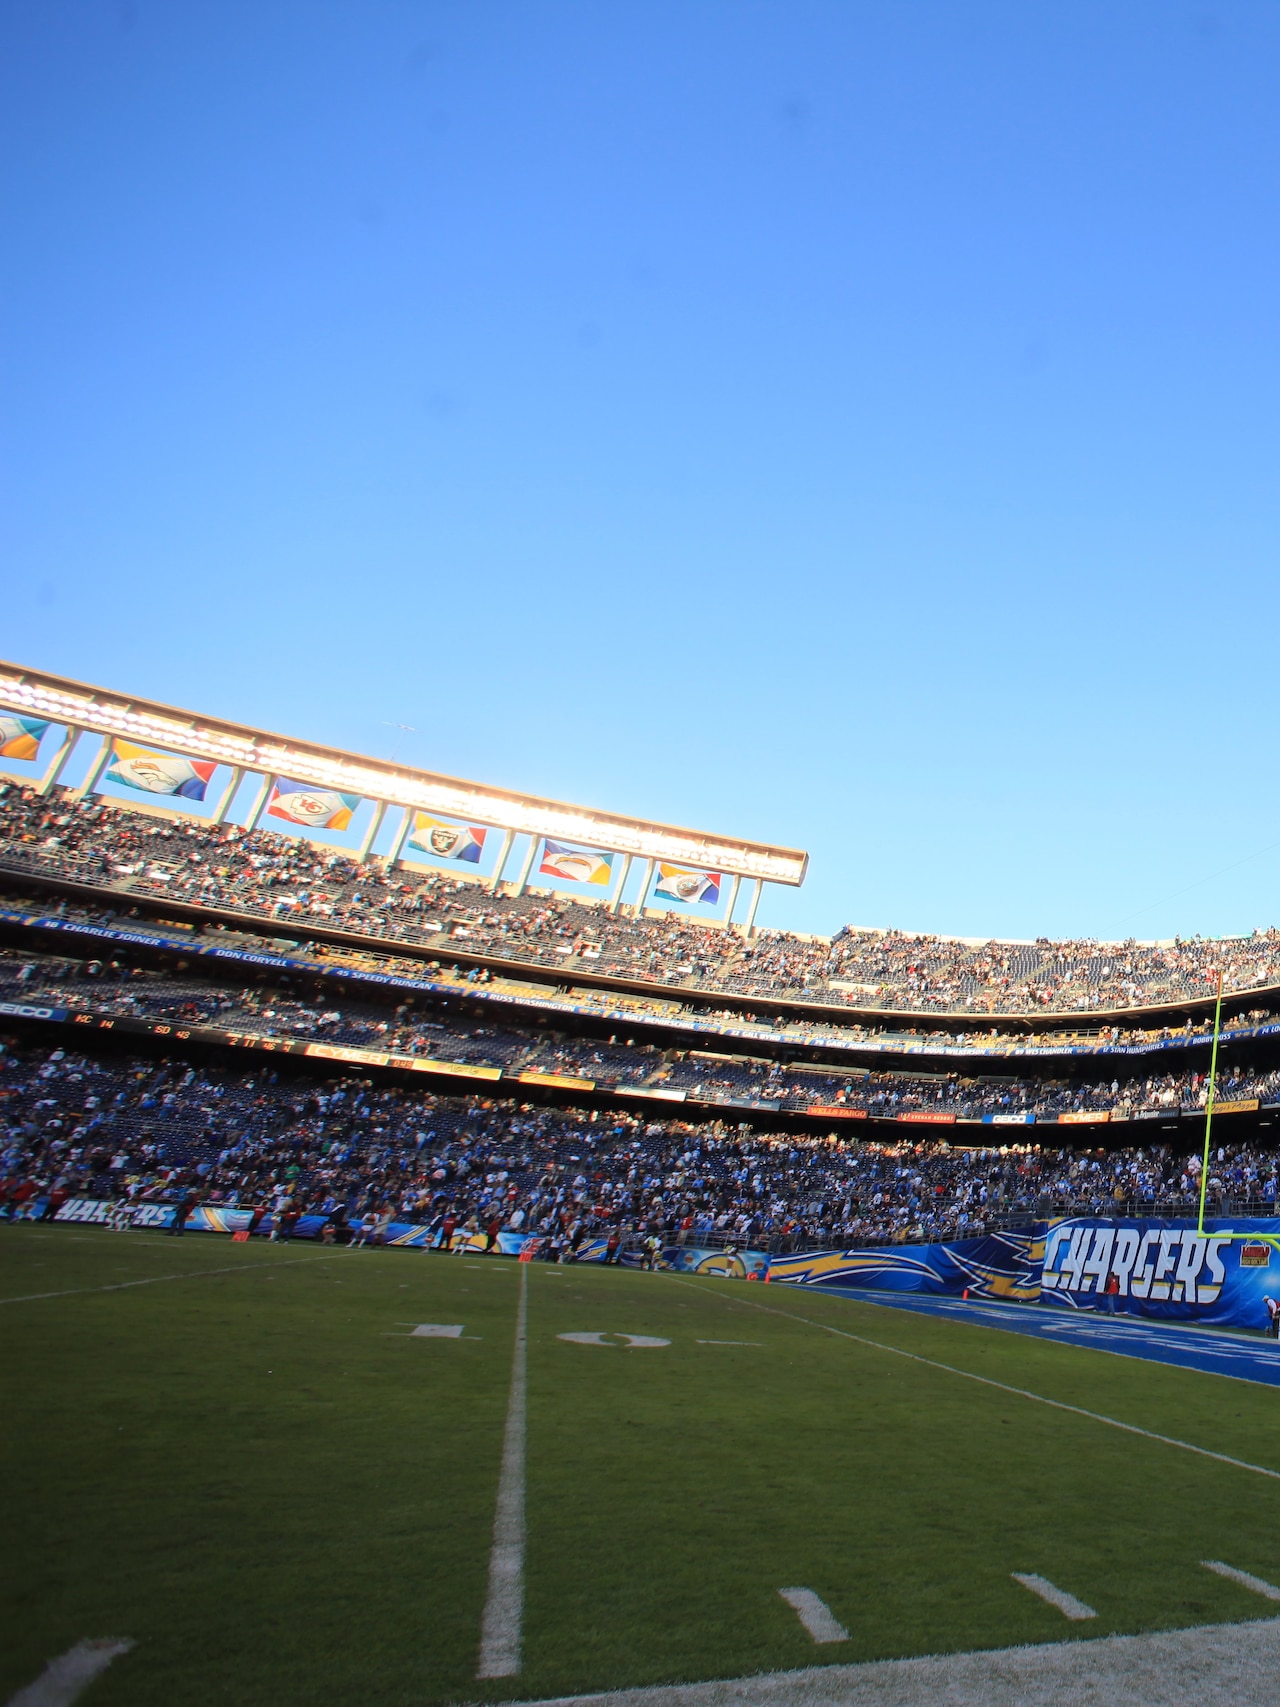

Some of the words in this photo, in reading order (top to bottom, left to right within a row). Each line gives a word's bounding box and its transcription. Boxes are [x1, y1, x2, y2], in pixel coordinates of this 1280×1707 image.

[63, 923, 115, 939] CHARLIE
[116, 932, 162, 946] JOINER
[215, 949, 242, 960] DON
[242, 953, 288, 968] CORYELL
[351, 971, 390, 984] SPEEDY
[390, 977, 433, 991] DUNCAN
[0, 1002, 53, 1019] EICO
[488, 993, 514, 1003] RUSS
[514, 997, 576, 1013] WASHINGTON
[154, 1025, 171, 1035] SD
[314, 1047, 383, 1063] CYMER
[810, 1107, 838, 1117] WELLS
[839, 1109, 867, 1118] FARGO
[992, 1114, 1027, 1124] GEICO
[1063, 1112, 1104, 1124] CYMER
[1041, 1227, 1234, 1304] CHARGERS
